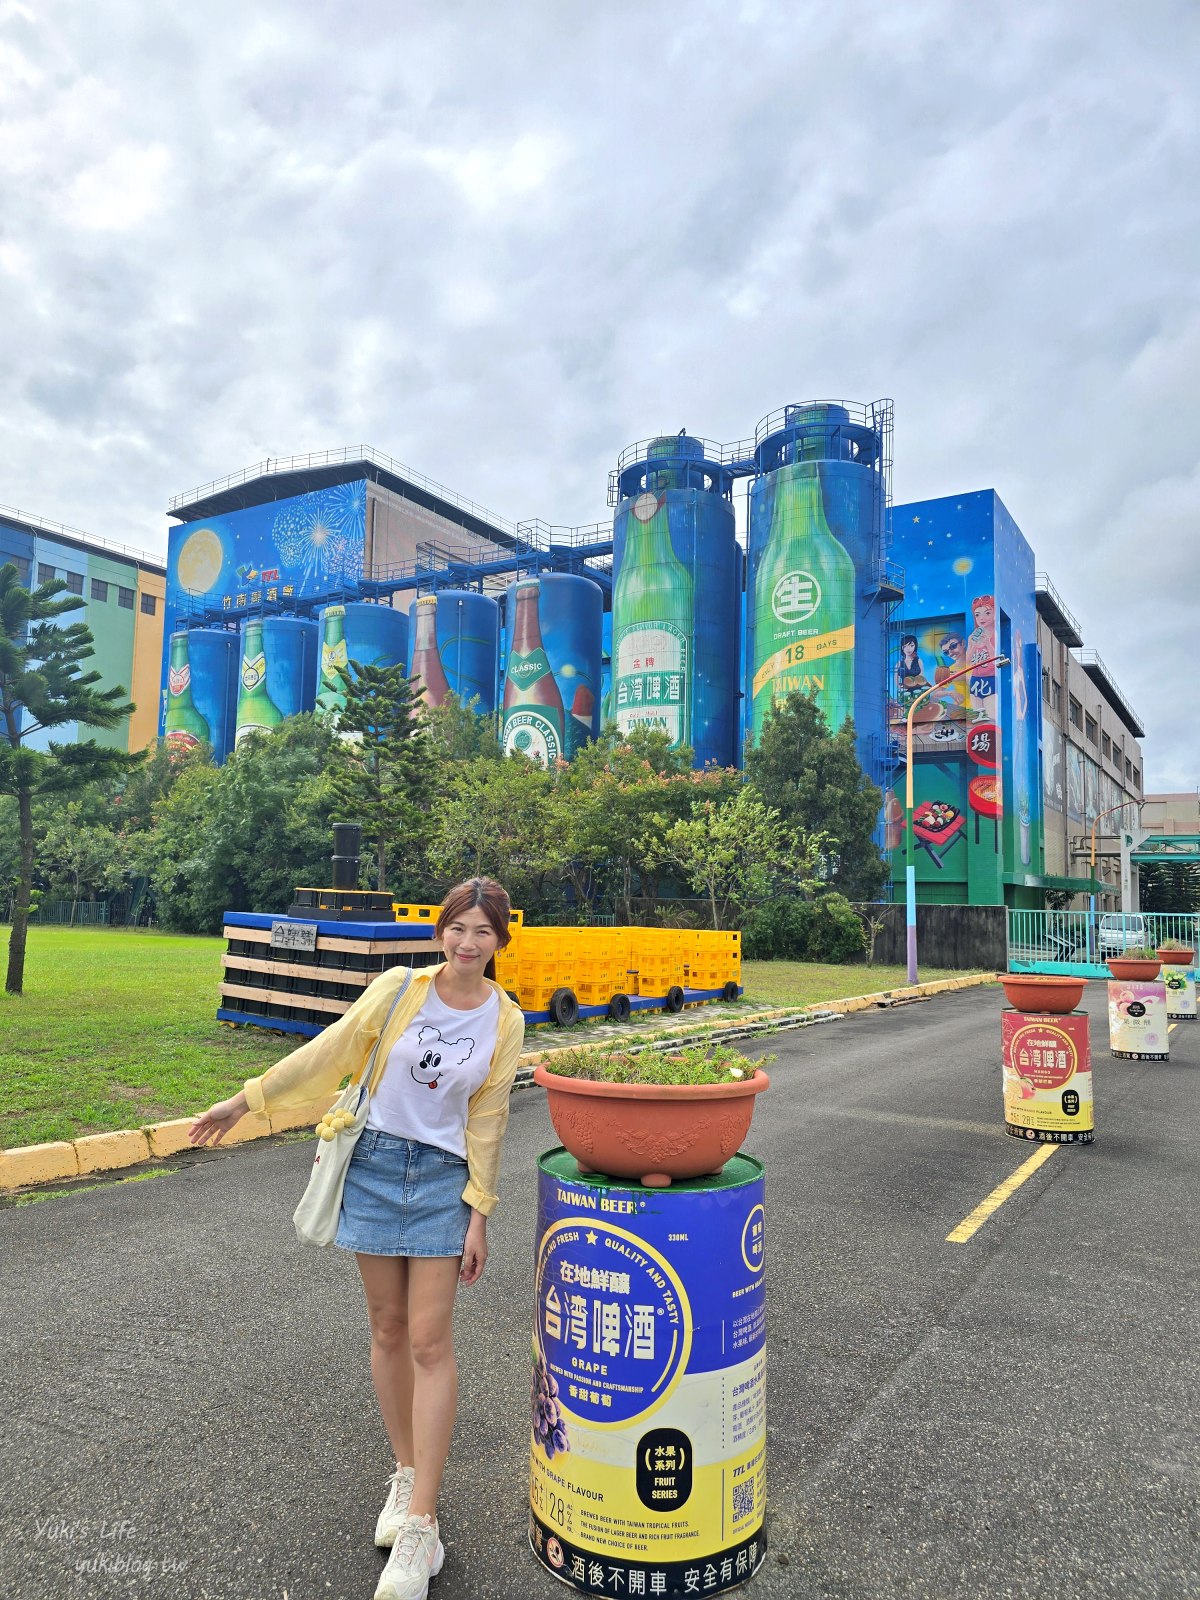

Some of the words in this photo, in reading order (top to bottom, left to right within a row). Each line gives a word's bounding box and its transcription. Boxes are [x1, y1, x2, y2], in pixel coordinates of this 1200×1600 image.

[776, 575, 814, 614] 生
[773, 629, 796, 640] DRAFT
[797, 628, 819, 636] BEER
[785, 644, 805, 664] 18
[816, 639, 838, 651] DAYS
[510, 663, 543, 675] CLASSIC
[512, 716, 533, 728] BEER
[535, 722, 557, 759] CLASSIC
[556, 1188, 597, 1210] TAIWAN
[600, 1198, 639, 1215] BEER
[556, 1231, 580, 1246] FRESH
[668, 1233, 689, 1242] 330ML
[604, 1237, 649, 1268] QUALITY
[645, 1267, 667, 1289] AND
[662, 1289, 680, 1325] TASTY
[732, 1287, 745, 1299] BEER
[571, 1357, 608, 1376] GRAPE
[573, 1373, 592, 1386] PASSION
[602, 1382, 644, 1394] CRAFTSMANSHIP
[654, 1446, 676, 1457] 水果
[654, 1460, 676, 1471] 系列
[546, 1469, 566, 1488] GRAPE
[567, 1481, 604, 1502] FLAVOUR
[654, 1477, 676, 1486] FRUIT
[651, 1490, 678, 1499] SERIES
[580, 1509, 599, 1521] BREWED
[613, 1518, 625, 1526] WITH
[626, 1520, 645, 1528] TAIWAN
[646, 1521, 670, 1529] TROPICAL
[580, 1520, 588, 1529] THE
[588, 1523, 604, 1533] FUSION
[610, 1529, 625, 1537] LAGER
[625, 1531, 638, 1539] BEER
[648, 1532, 660, 1540] RICH
[660, 1532, 674, 1540] FRUIT
[580, 1531, 595, 1542] BRAND
[596, 1536, 607, 1544] NEW
[607, 1539, 626, 1549] CHOICE
[570, 1553, 667, 1596] 酒後不開車
